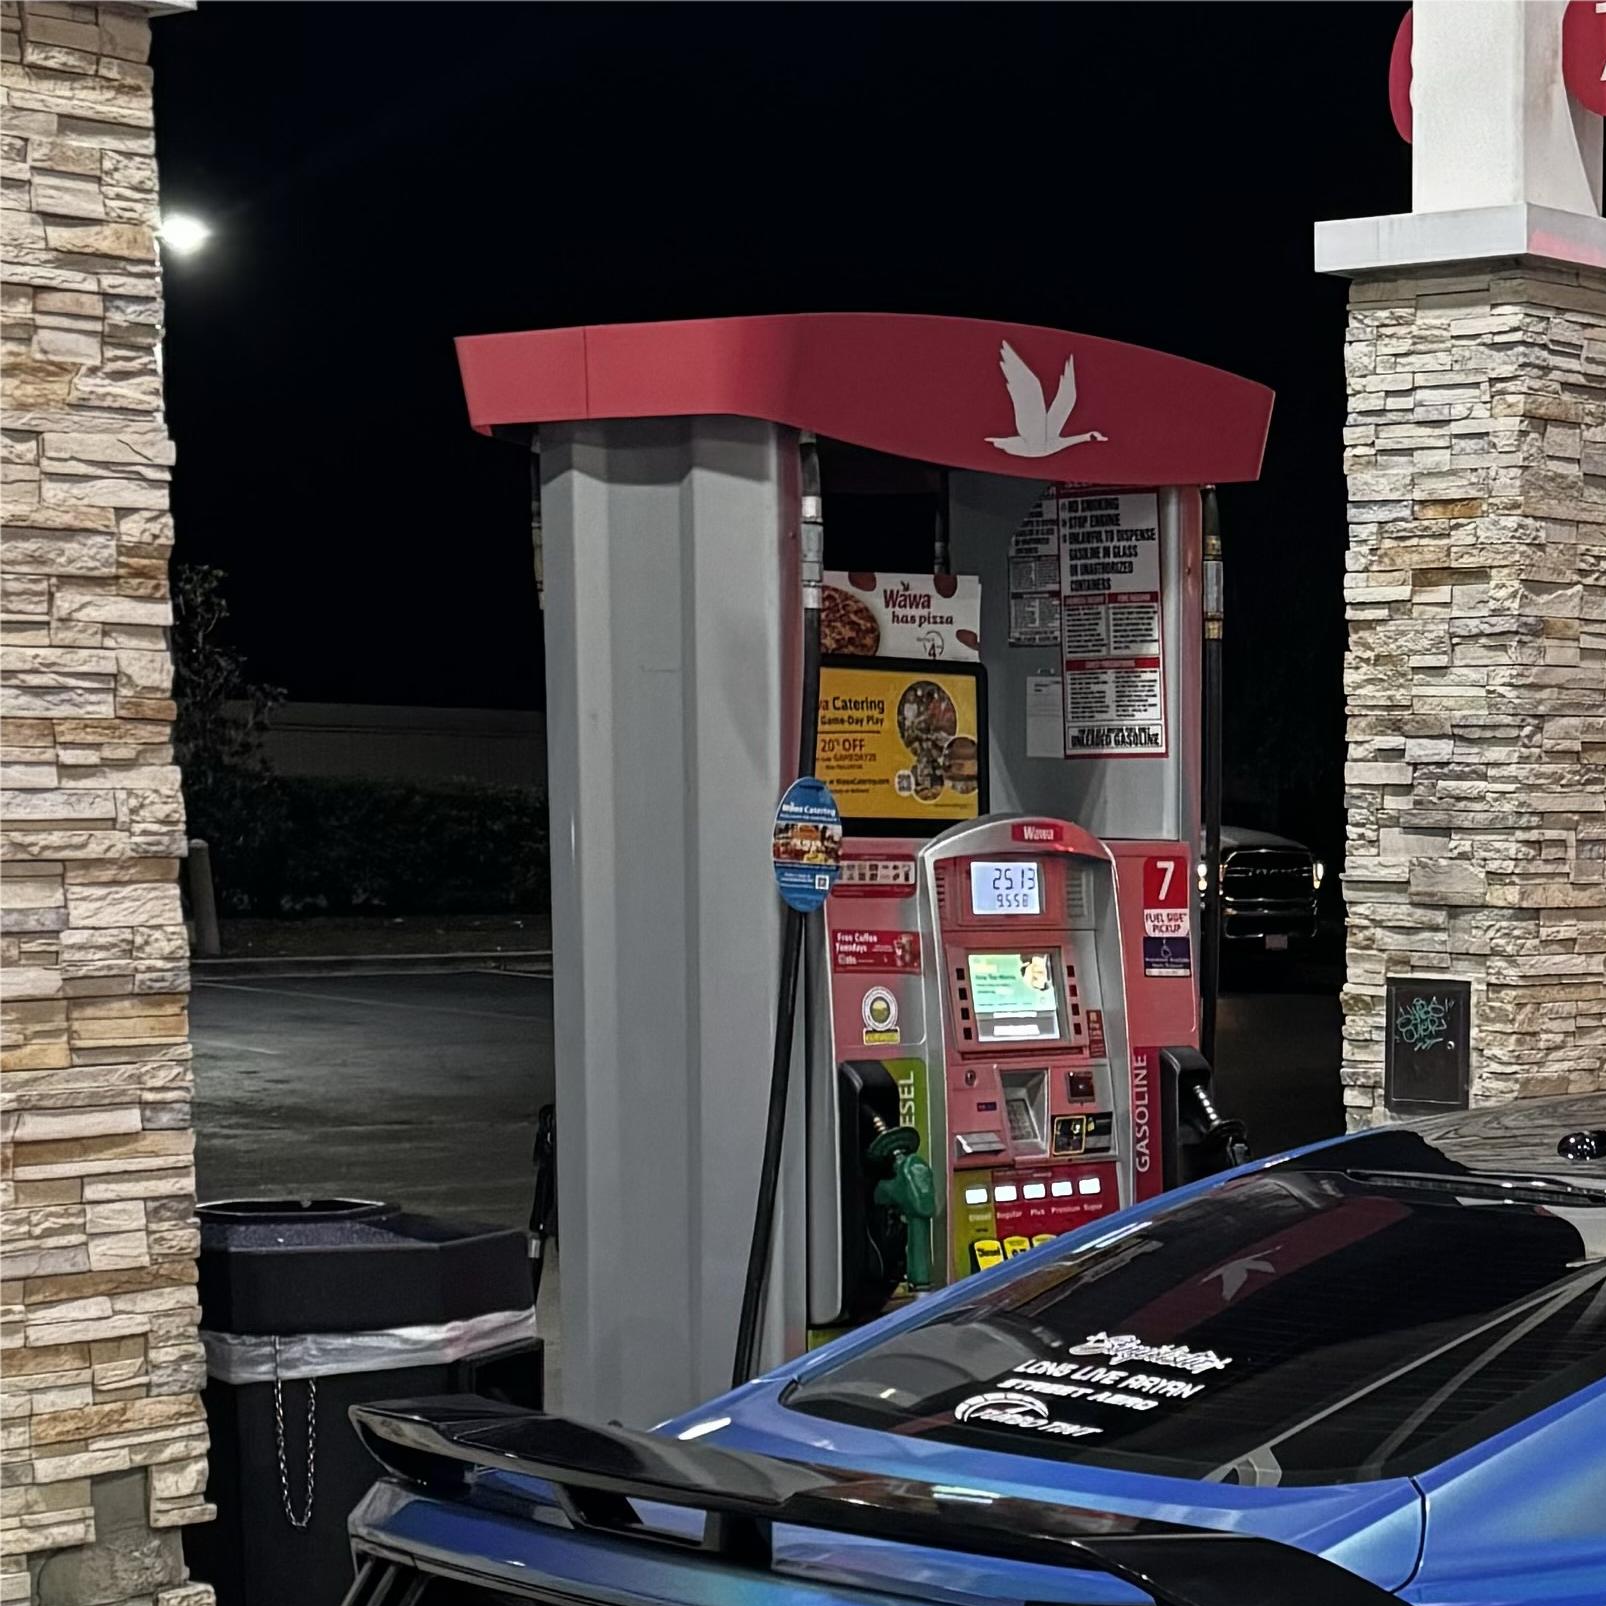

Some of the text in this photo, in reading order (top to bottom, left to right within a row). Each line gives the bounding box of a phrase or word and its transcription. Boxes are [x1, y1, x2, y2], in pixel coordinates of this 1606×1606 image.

[1116, 528, 1156, 542] DISPENSE
[1112, 544, 1138, 558] GLASS
[883, 589, 931, 610] Wawa
[891, 611, 953, 628] has pizza
[832, 696, 885, 714] Catering
[842, 738, 865, 752] OFF
[1023, 826, 1054, 840] Wawa
[1156, 861, 1175, 900] 7
[1145, 912, 1165, 923] FUEL
[1152, 924, 1181, 933] PICKUP
[836, 932, 853, 942] Free
[1134, 1054, 1150, 1172] GASOLINE
[996, 1210, 1022, 1220] Regular
[1051, 1205, 1080, 1214] Premium
[1013, 1359, 1079, 1378] LONG
[1070, 1365, 1129, 1384] LIVE
